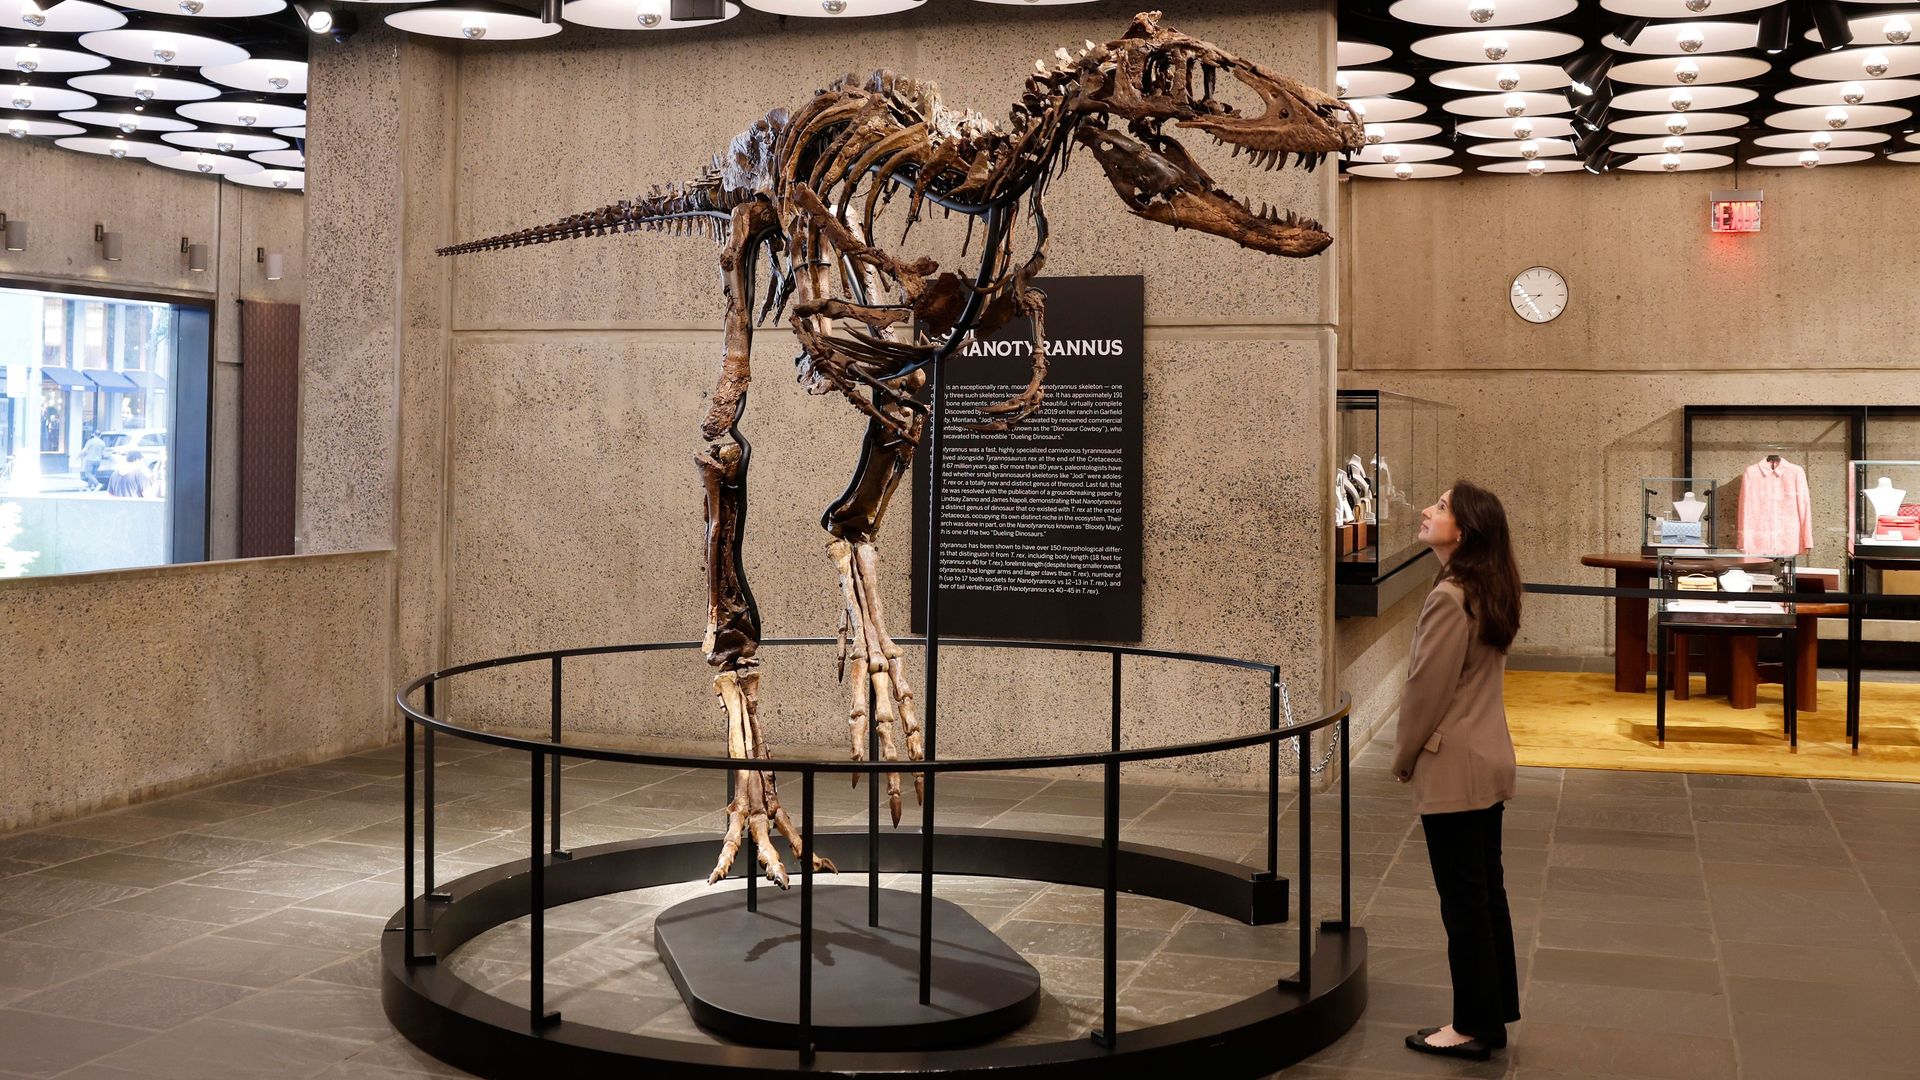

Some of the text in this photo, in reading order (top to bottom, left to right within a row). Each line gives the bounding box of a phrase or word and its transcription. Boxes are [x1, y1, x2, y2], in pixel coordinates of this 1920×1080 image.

[1719, 202, 1756, 229] EXIT
[960, 383, 996, 391] exceptionally
[1072, 391, 1112, 400] approximately
[1070, 400, 1094, 408] virtually
[1095, 400, 1122, 408] complete
[1008, 433, 1032, 441] "Dueling
[998, 446, 1015, 454] highly
[1016, 446, 1047, 455] specialized
[1082, 447, 1122, 456] tyrannosaurid
[957, 454, 984, 462] alongside
[986, 454, 1027, 463] Tyrannosaurus
[1065, 464, 1107, 472] paleontologists
[992, 471, 1031, 480] tyrannosaurid
[970, 479, 987, 487] totally
[1008, 488, 1039, 496] publication
[1051, 489, 1096, 497] groundbreaking
[941, 495, 962, 503] Lindsay
[1029, 497, 1070, 505] demonstrating
[1082, 498, 1121, 506] Nanotyrannus
[972, 512, 1000, 521] occupying
[1017, 521, 1055, 530] Nanotyrannus
[1083, 523, 1105, 531] "Bloody
[991, 529, 1014, 538] "Dueling
[1062, 544, 1104, 553] morphological
[959, 550, 989, 559] distinguish
[1028, 552, 1054, 561] including
[1055, 552, 1069, 561] body
[1090, 553, 1100, 562] (18
[1067, 561, 1082, 570] being
[979, 567, 996, 576] longer
[1024, 568, 1040, 577] larger
[944, 574, 954, 583] (up
[1017, 576, 1056, 586] Nanotyrannus
[993, 584, 1002, 592] (35
[1009, 585, 1047, 594] Nanotyrannus
